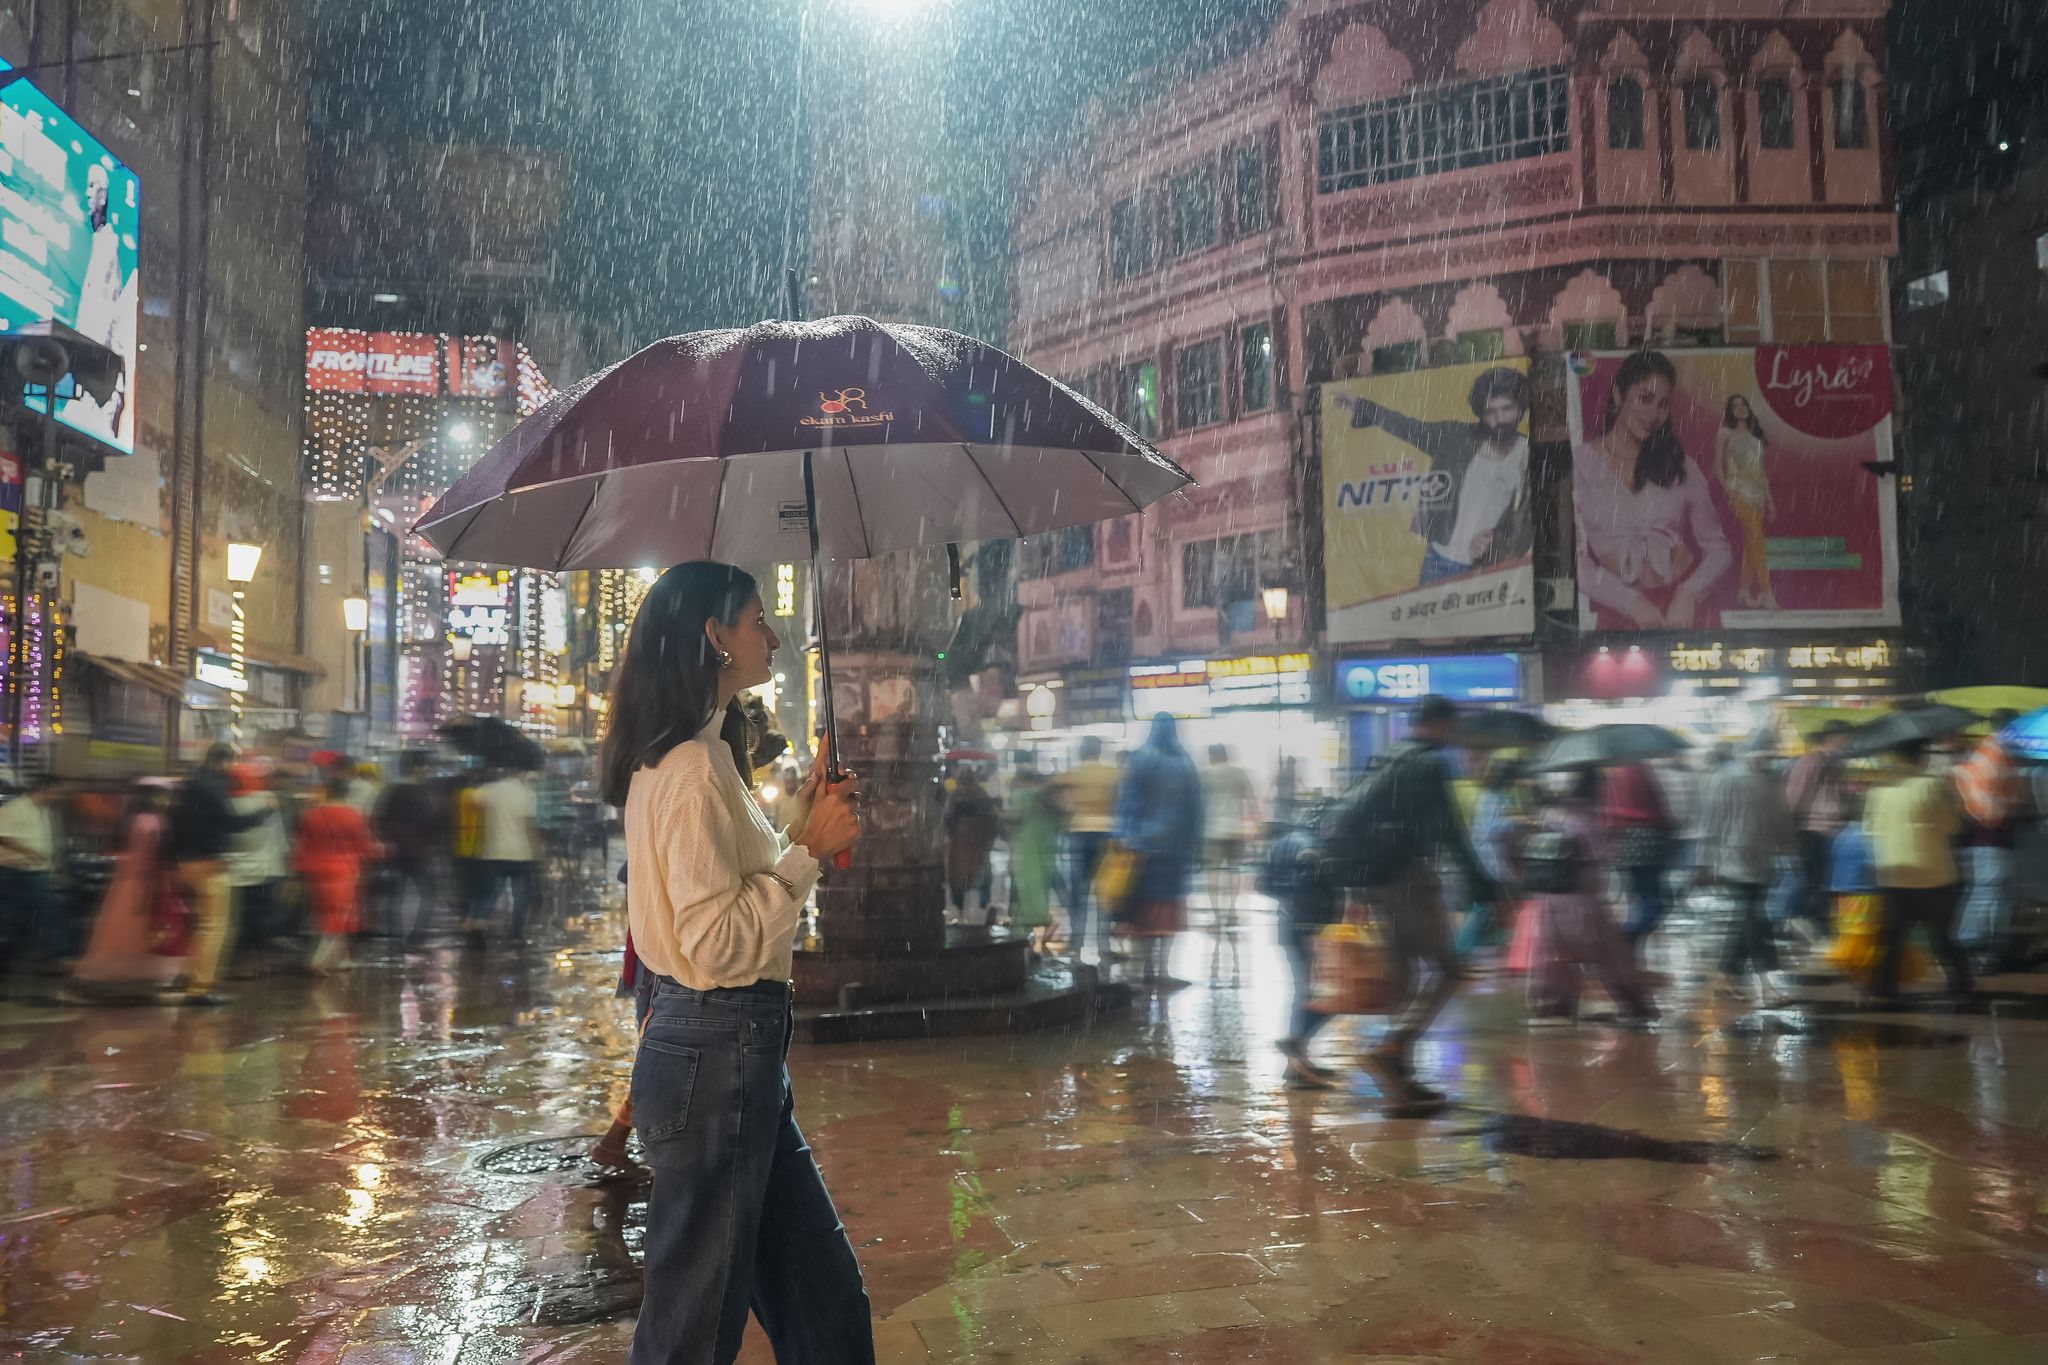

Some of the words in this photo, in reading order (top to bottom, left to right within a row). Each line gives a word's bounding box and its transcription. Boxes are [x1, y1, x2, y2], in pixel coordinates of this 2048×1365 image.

[310, 350, 434, 375] FRONTLINE
[1767, 350, 1857, 408] Lyra
[800, 415, 845, 425] ekam
[848, 411, 894, 424] kashi
[1407, 600, 1437, 619] अंदर
[1466, 589, 1494, 606] बात
[1377, 664, 1430, 699] SBI
